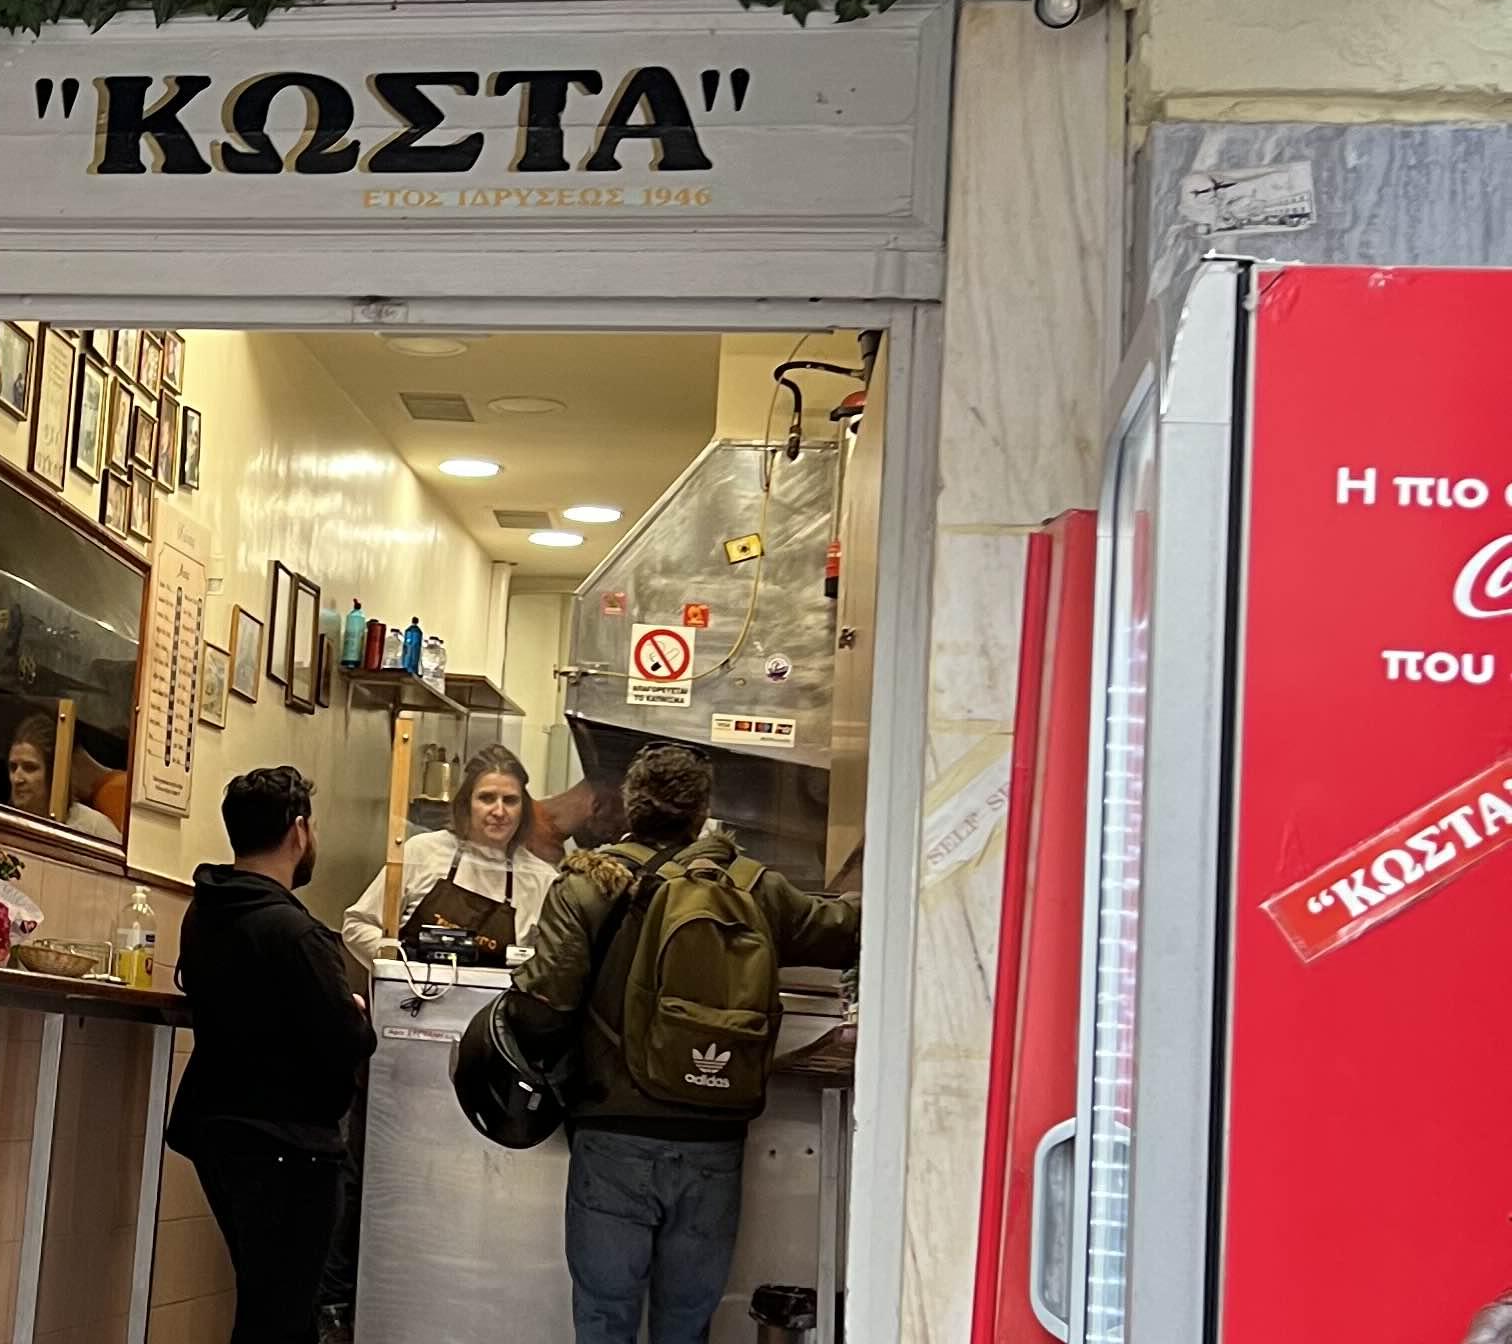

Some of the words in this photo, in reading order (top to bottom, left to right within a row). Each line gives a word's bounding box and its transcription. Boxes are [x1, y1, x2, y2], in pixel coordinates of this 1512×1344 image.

[35, 66, 750, 175] "ΚΩΣΤΑ"
[361, 187, 444, 209] ΕΤΟΣ
[457, 186, 625, 208] ΙΔΡΥΣΕΩΣ
[642, 186, 713, 207] 1946
[1335, 466, 1377, 505] Η
[1392, 475, 1489, 508] πιο
[1381, 649, 1495, 684] που
[926, 812, 979, 865] SELF
[684, 1073, 730, 1088] adidas
